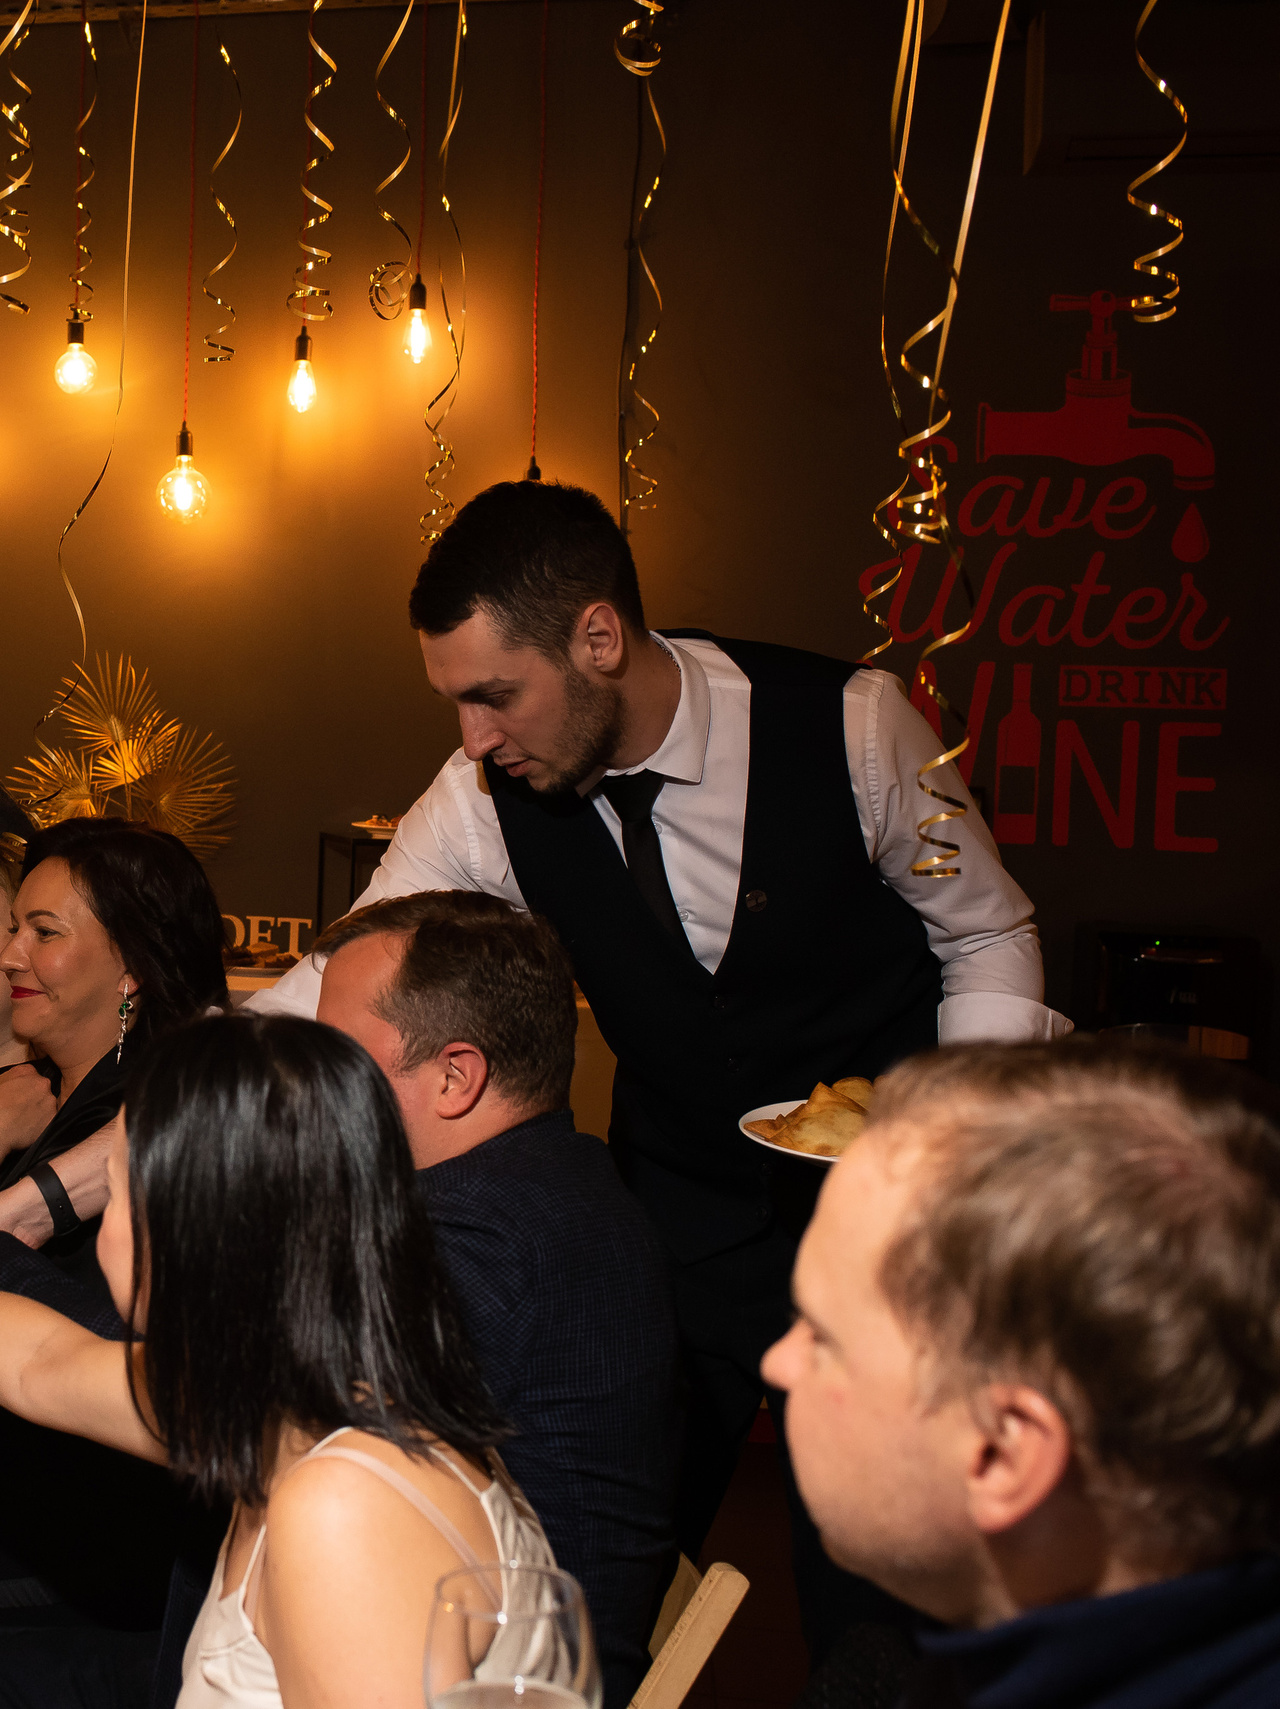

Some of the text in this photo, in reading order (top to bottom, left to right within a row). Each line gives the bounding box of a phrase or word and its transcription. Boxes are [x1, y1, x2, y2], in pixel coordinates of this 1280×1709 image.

[887, 435, 1157, 540] Save
[858, 542, 1231, 651] Water
[1062, 670, 1221, 705] DRINK
